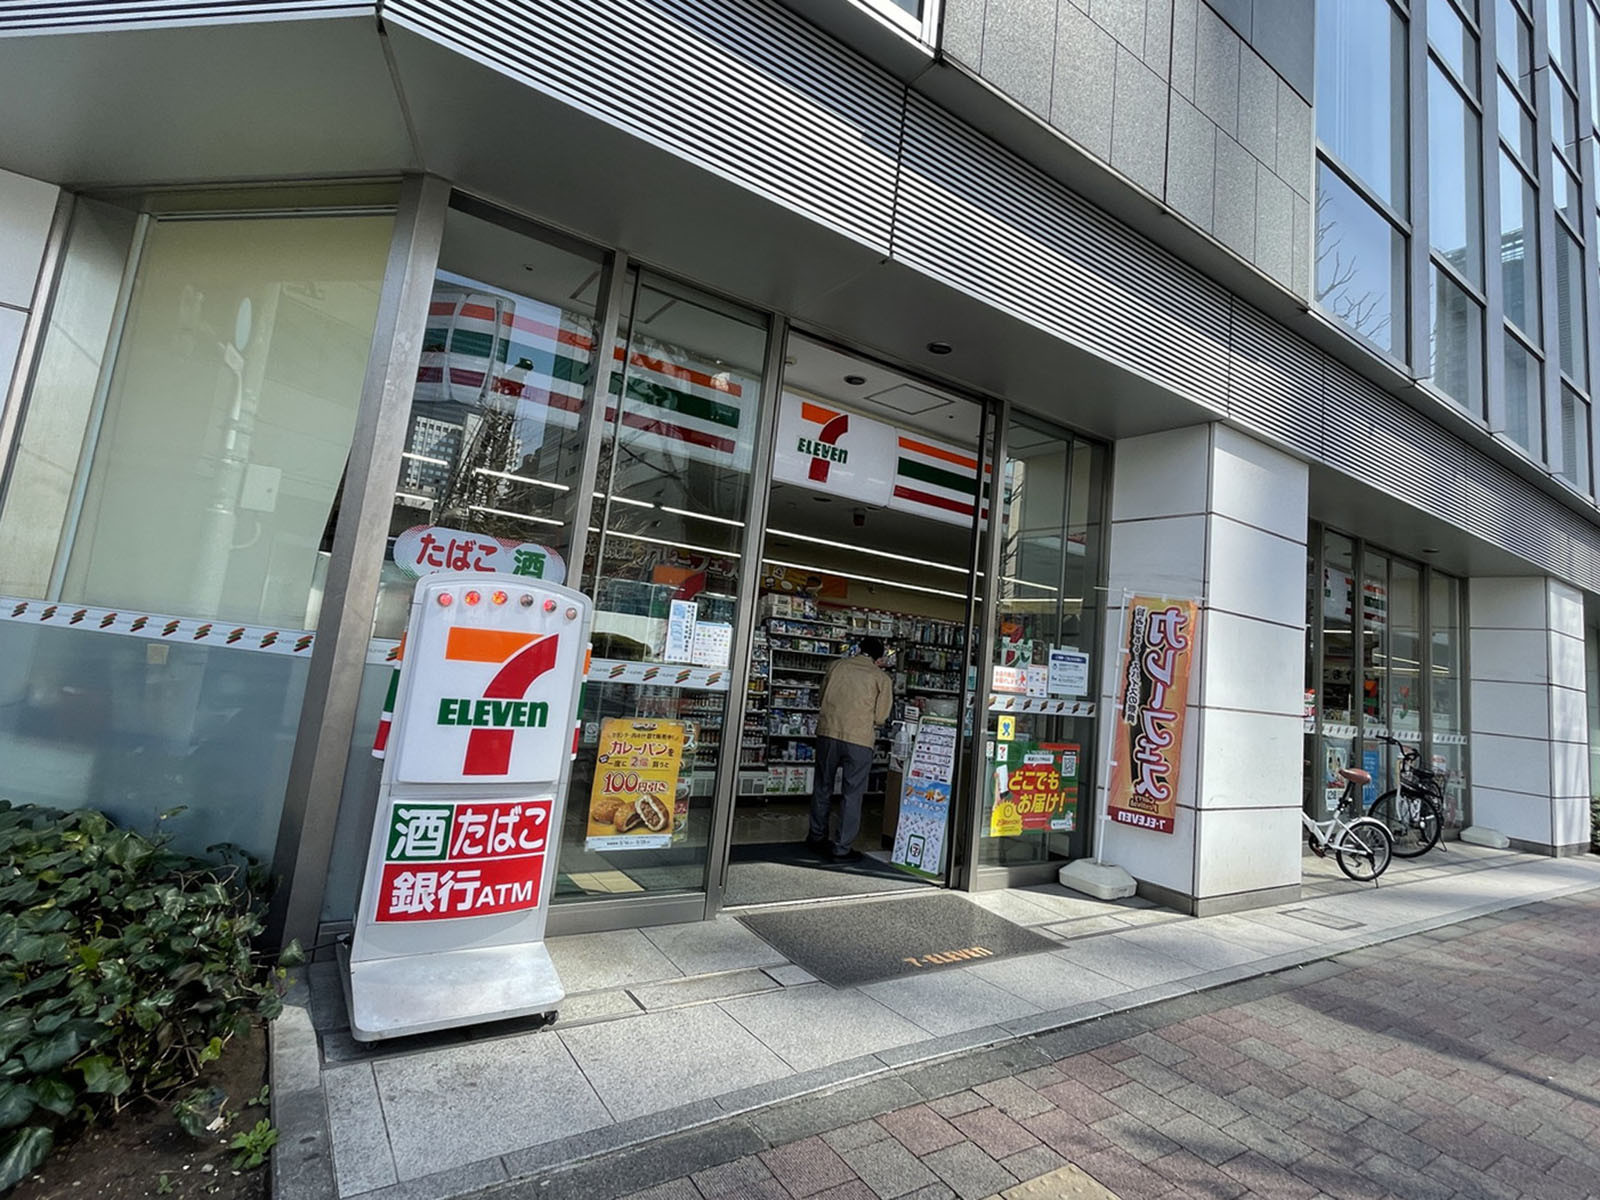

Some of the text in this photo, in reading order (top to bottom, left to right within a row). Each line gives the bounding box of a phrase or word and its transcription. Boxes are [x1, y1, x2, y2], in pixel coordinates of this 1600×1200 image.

[416, 533, 547, 579] たばこ 酒
[603, 772, 668, 793] 100円引き
[905, 786, 946, 802] クーポン
[1008, 771, 1059, 791] どこでも
[391, 805, 547, 859] 酒 たばこ
[389, 870, 533, 914] 銀行ATM
